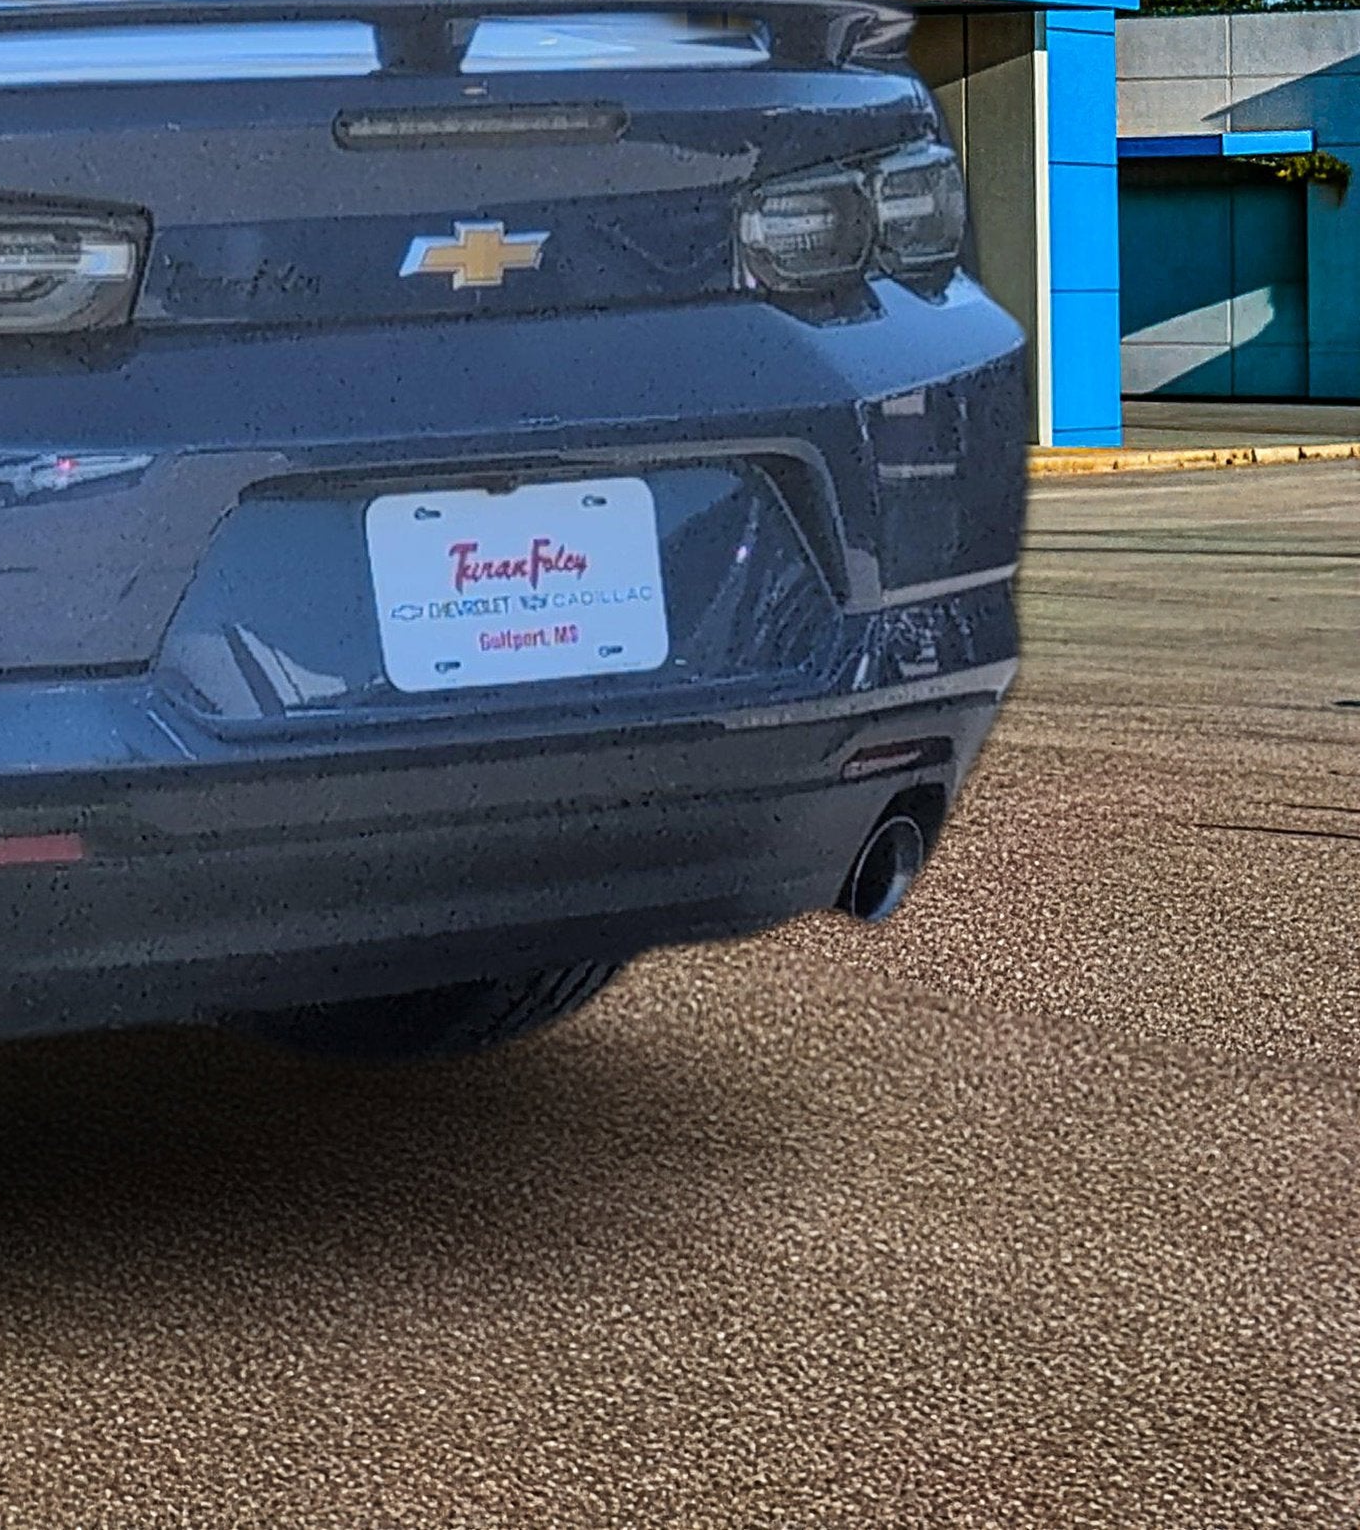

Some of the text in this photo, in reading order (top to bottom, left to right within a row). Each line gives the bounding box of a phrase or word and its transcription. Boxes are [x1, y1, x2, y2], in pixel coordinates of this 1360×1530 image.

[428, 585, 653, 619] CHEVROLET CADILLAC
[553, 623, 580, 645] MS
